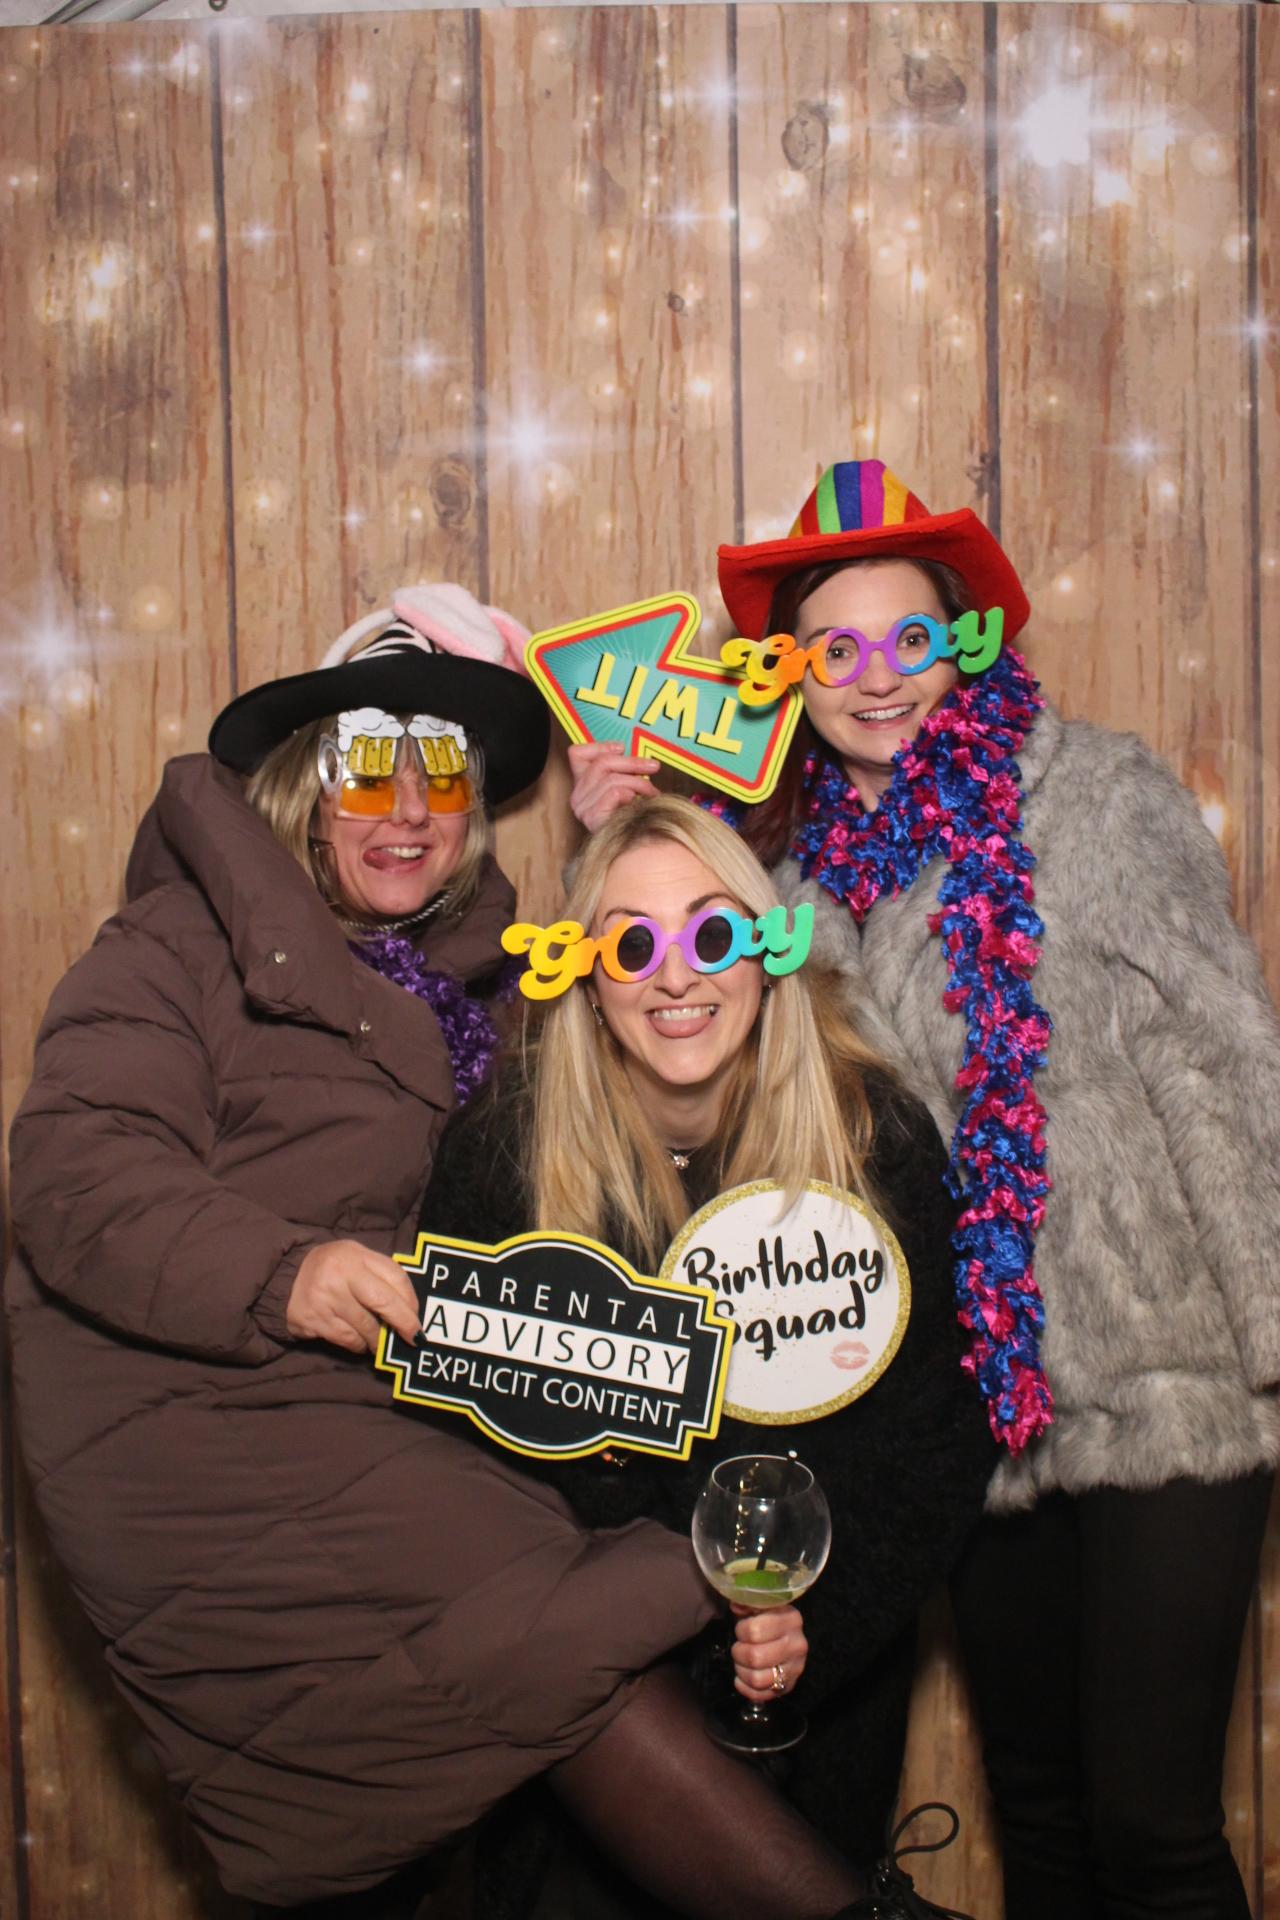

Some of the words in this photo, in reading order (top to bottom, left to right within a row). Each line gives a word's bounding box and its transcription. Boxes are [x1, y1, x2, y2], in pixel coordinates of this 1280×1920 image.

[575, 652, 744, 755] TWIT
[682, 1229, 884, 1294] Birthday
[431, 1263, 692, 1341] PARENTAL
[424, 1305, 688, 1388] ADVISORY
[417, 1350, 538, 1399] EXPLICIT
[542, 1377, 681, 1429] CONTENT
